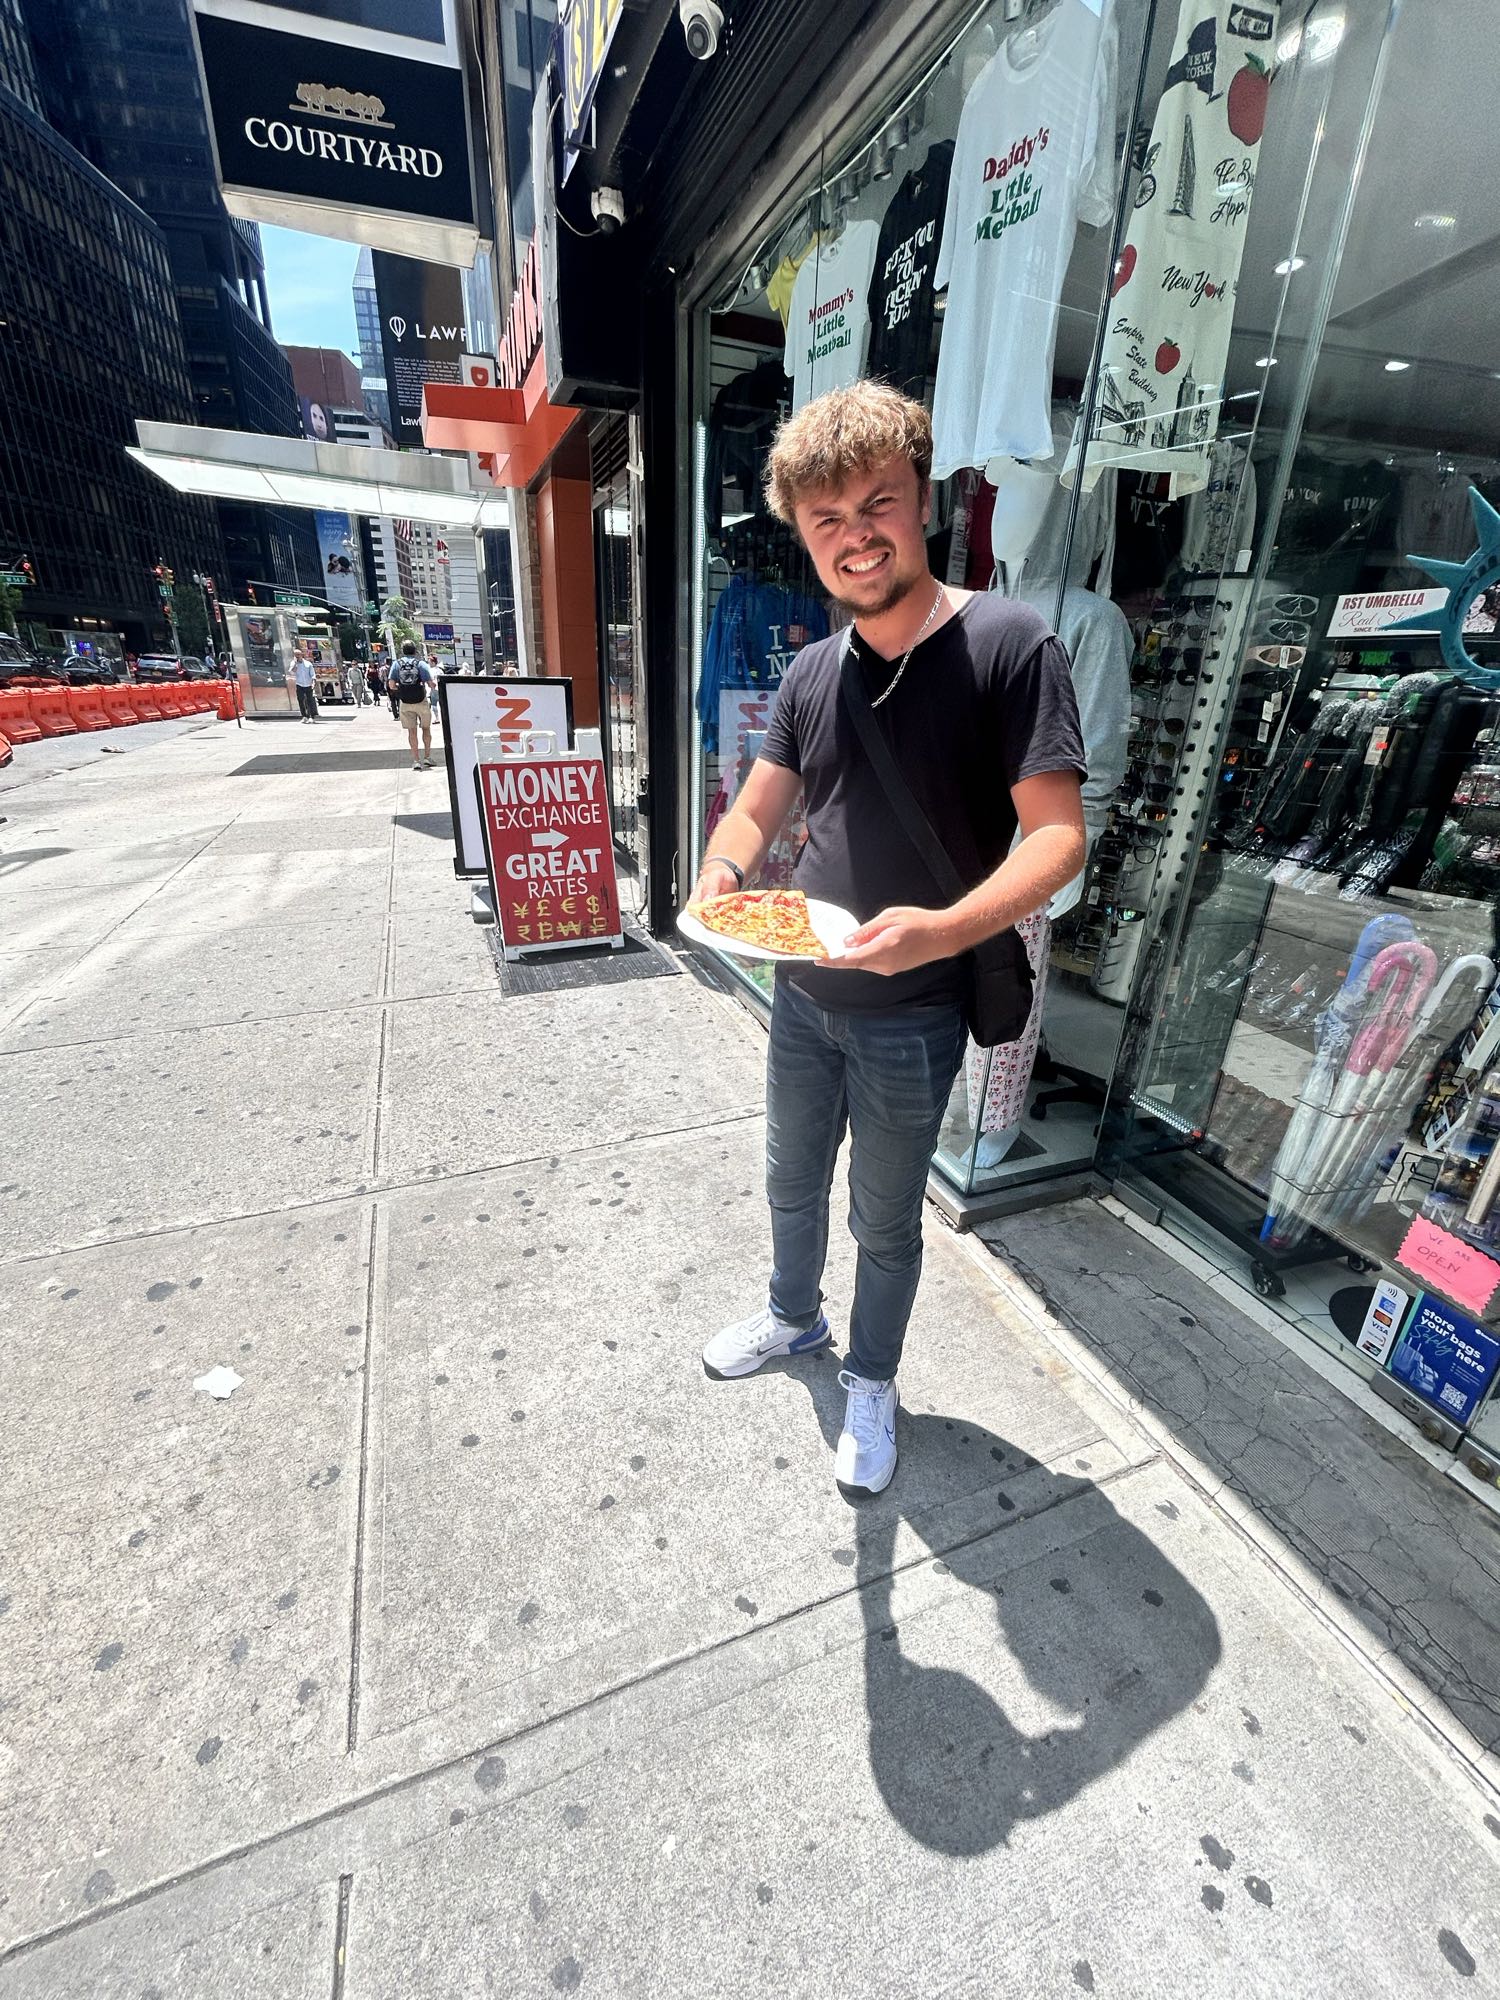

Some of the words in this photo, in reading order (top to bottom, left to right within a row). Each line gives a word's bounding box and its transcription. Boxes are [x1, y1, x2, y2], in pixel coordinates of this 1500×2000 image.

[1185, 62, 1213, 80] YORK
[1187, 50, 1211, 66] NEW
[244, 117, 443, 178] COURTYARD
[983, 127, 1050, 184] Daddy's
[1162, 265, 1195, 292] New
[808, 288, 854, 325] Mommy's
[816, 312, 846, 340] Little
[1112, 318, 1145, 345] Empire
[807, 328, 852, 364] Meatball
[1126, 345, 1148, 369] State
[1128, 368, 1158, 403] Building
[1342, 596, 1365, 610] RST
[1365, 592, 1425, 609] UMBRELLA
[1338, 610, 1378, 627] Real
[768, 624, 783, 650] I
[489, 766, 598, 806] MONEY
[494, 803, 602, 830] EXCHANGE
[506, 848, 601, 880] GREAT
[528, 877, 588, 899] RATES
[1417, 1246, 1461, 1273] OPEN
[1372, 1321, 1389, 1336] VISA
[1423, 1308, 1455, 1332] store
[1420, 1315, 1450, 1337] your
[1450, 1334, 1481, 1359] bags
[1455, 1348, 1485, 1373] here
